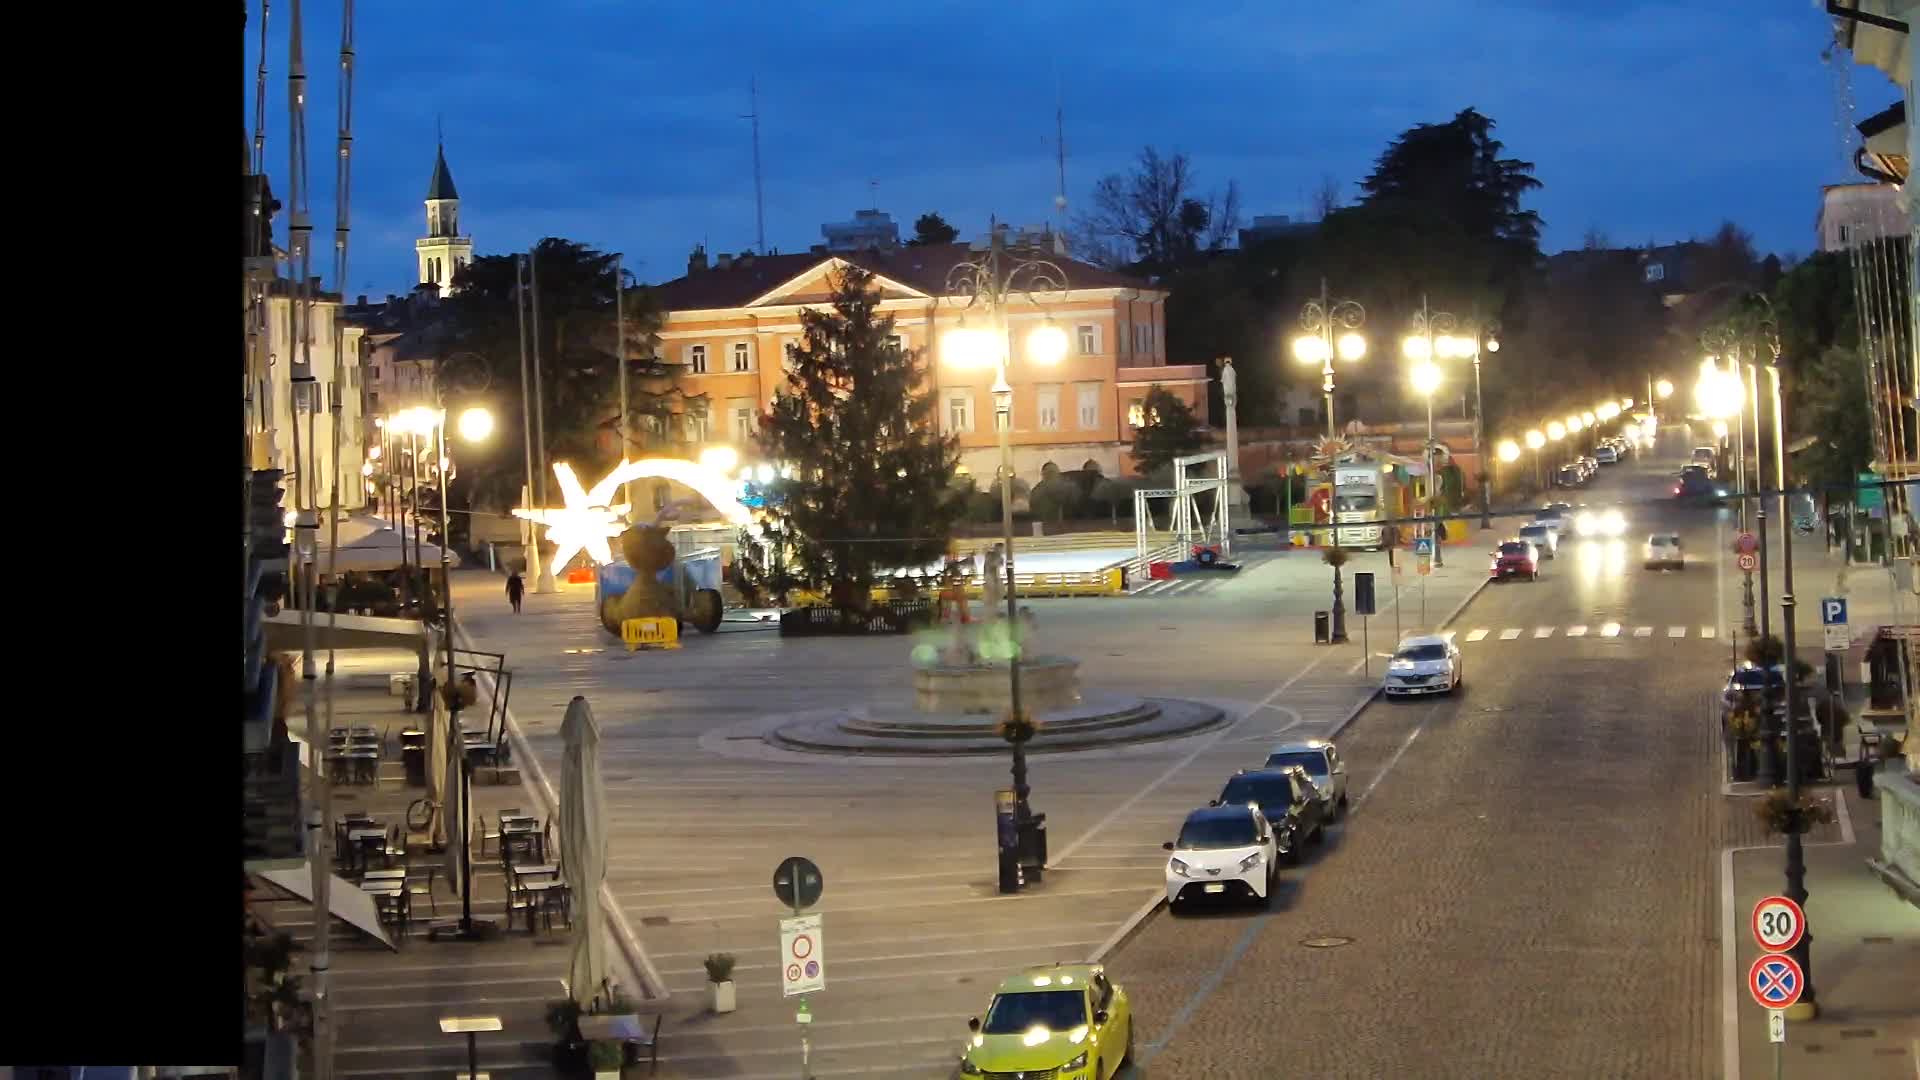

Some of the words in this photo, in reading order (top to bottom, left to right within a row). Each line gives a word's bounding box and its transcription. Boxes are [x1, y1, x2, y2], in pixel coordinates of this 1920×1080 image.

[1742, 557, 1753, 567] 20
[1827, 602, 1842, 622] P
[1762, 911, 1792, 937] 30
